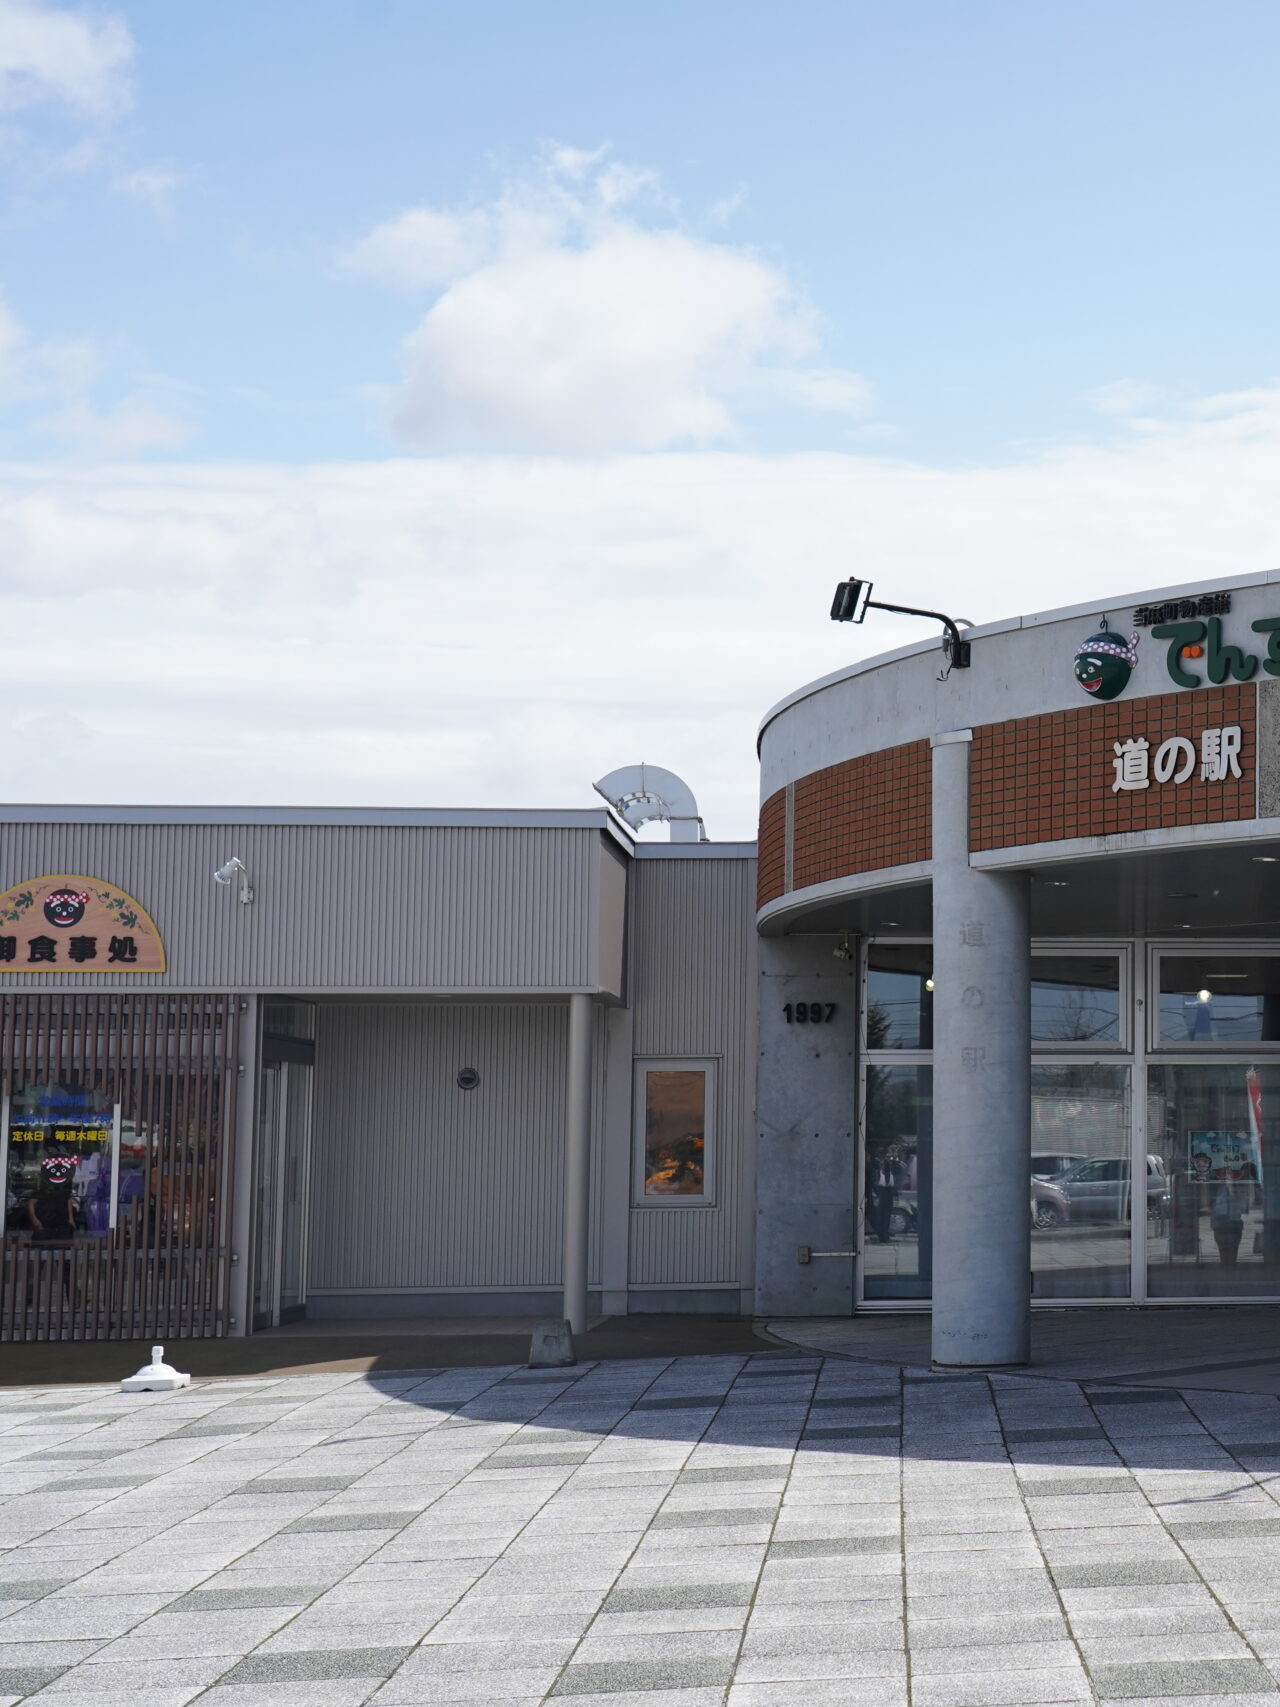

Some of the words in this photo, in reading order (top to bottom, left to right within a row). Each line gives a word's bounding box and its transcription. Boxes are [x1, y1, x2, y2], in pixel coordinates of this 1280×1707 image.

[1112, 725, 1243, 793] 道の駅
[782, 1002, 837, 1024] 1997
[12, 1131, 44, 1141] 定休日
